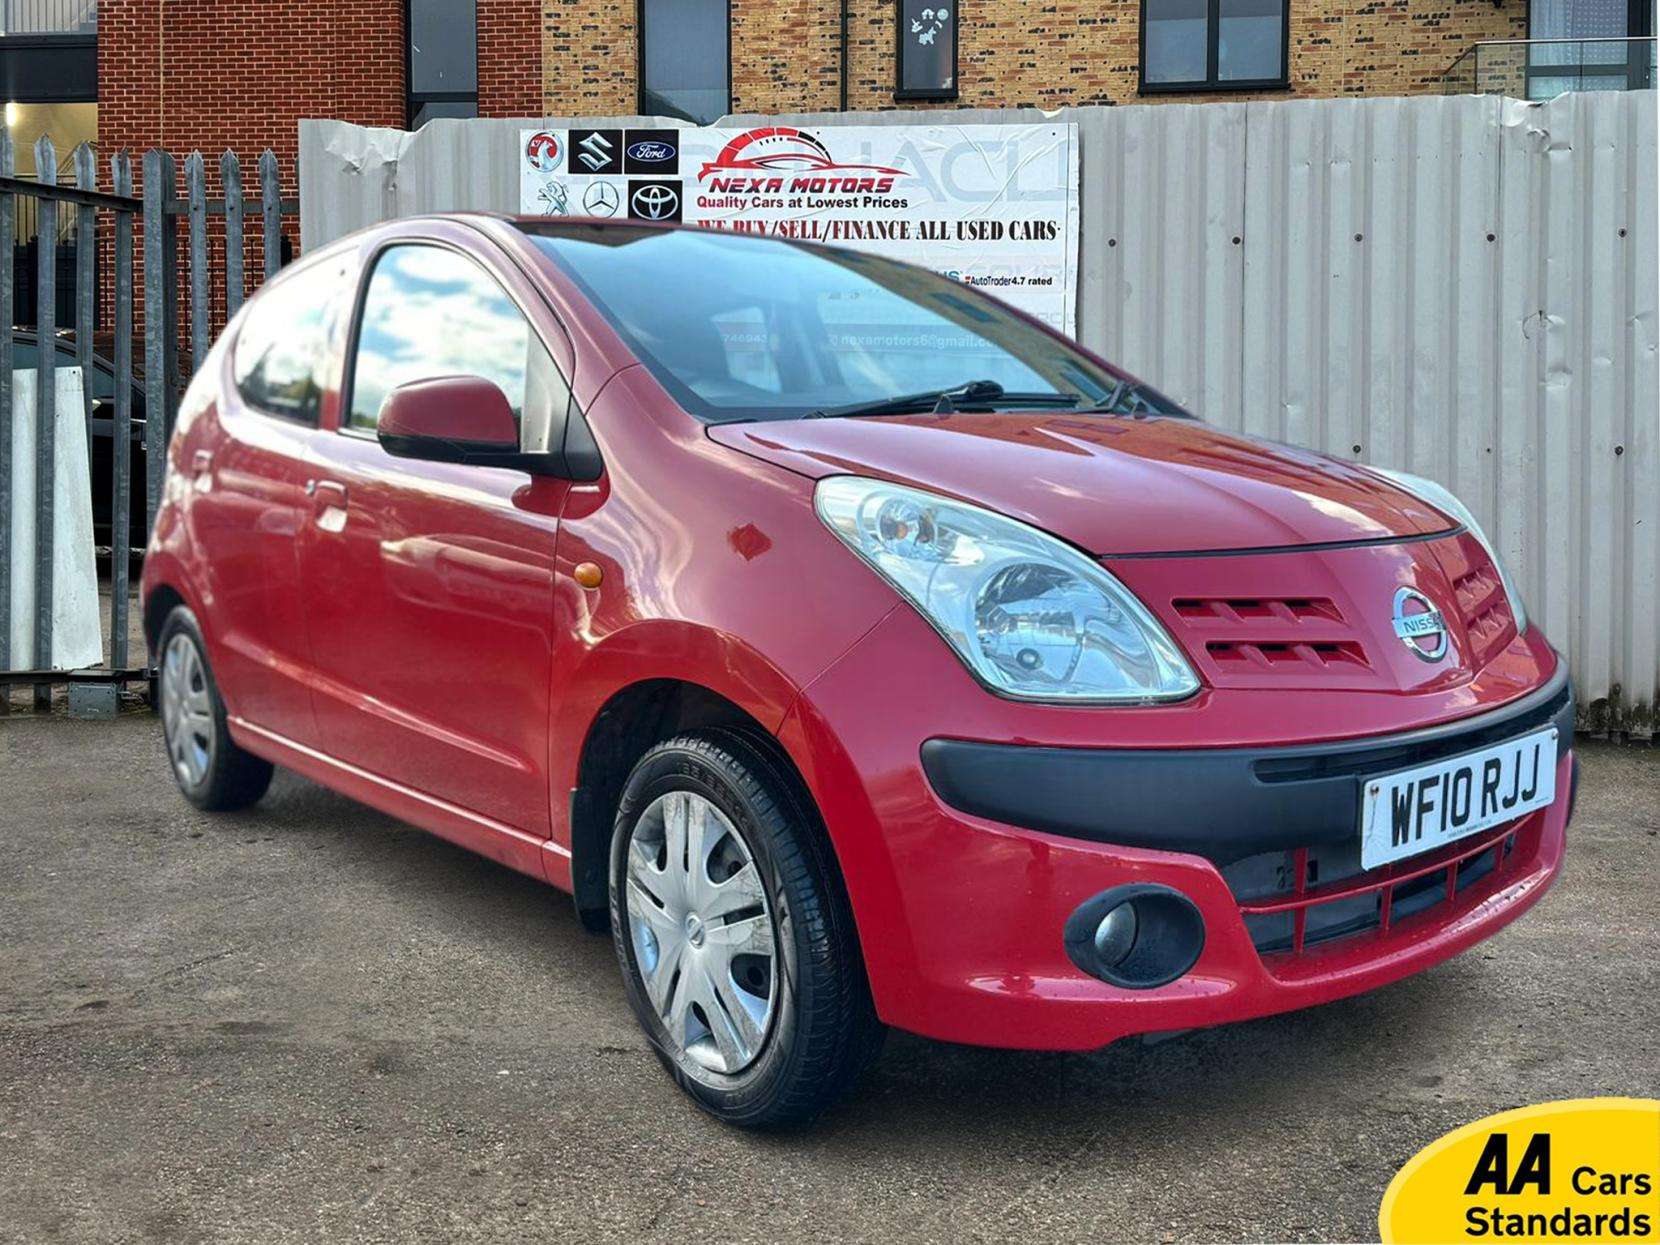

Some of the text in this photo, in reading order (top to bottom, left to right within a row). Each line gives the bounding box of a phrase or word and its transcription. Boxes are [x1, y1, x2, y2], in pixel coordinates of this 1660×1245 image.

[636, 143, 666, 160] Ford
[709, 177, 895, 194] NEXA MOTORS
[696, 195, 908, 210] Quality Cars at Lowest Prices
[916, 219, 951, 240] ALL
[956, 219, 1003, 240] USED
[1009, 219, 1056, 240] CARS
[1028, 276, 1053, 285] rated
[1391, 743, 1541, 848] WF10 RJJ
